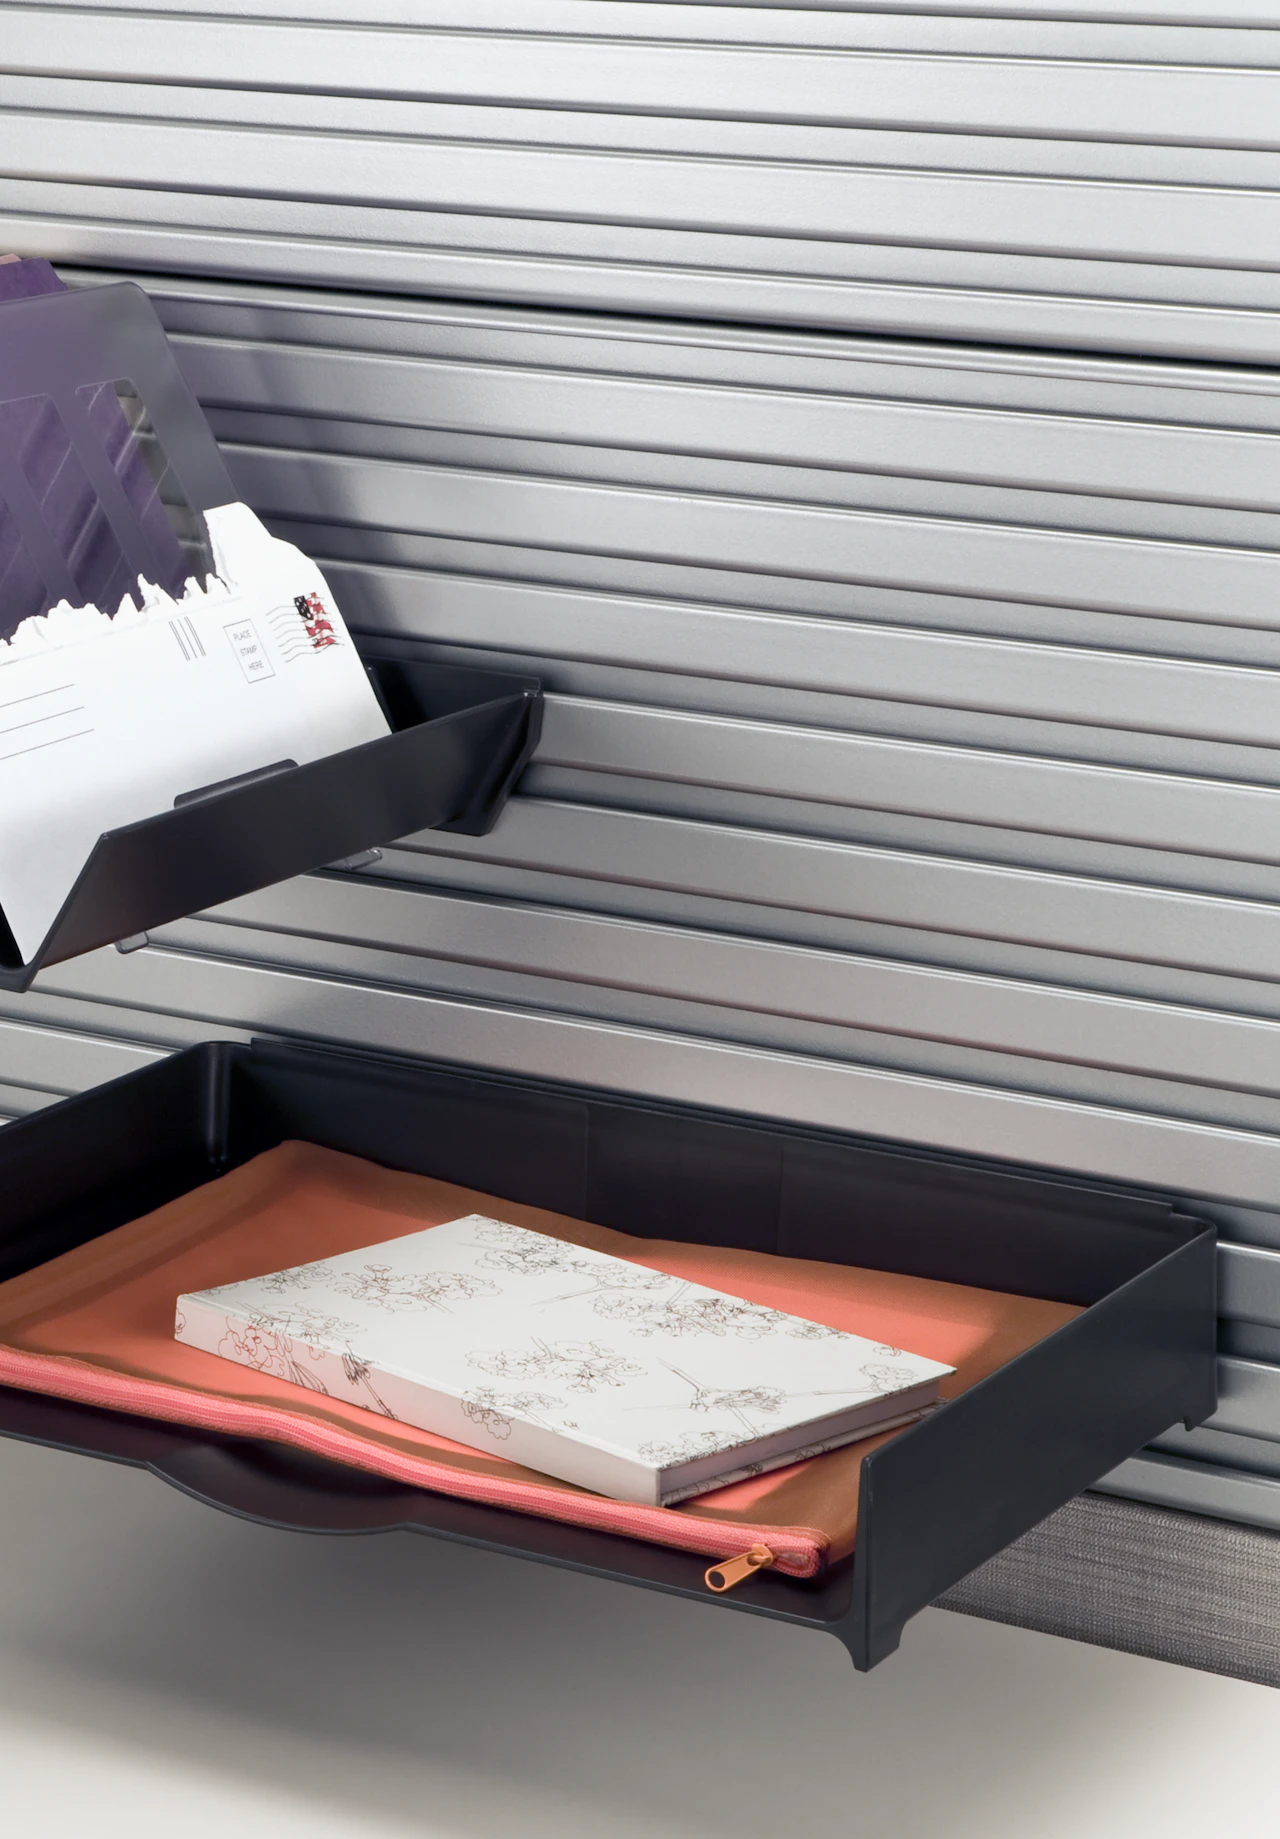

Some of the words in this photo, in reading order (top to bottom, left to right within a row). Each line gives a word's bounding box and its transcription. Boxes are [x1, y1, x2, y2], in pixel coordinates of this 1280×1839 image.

[233, 629, 253, 641] PLACE
[240, 644, 258, 657] STAMP
[248, 660, 264, 671] HERE
